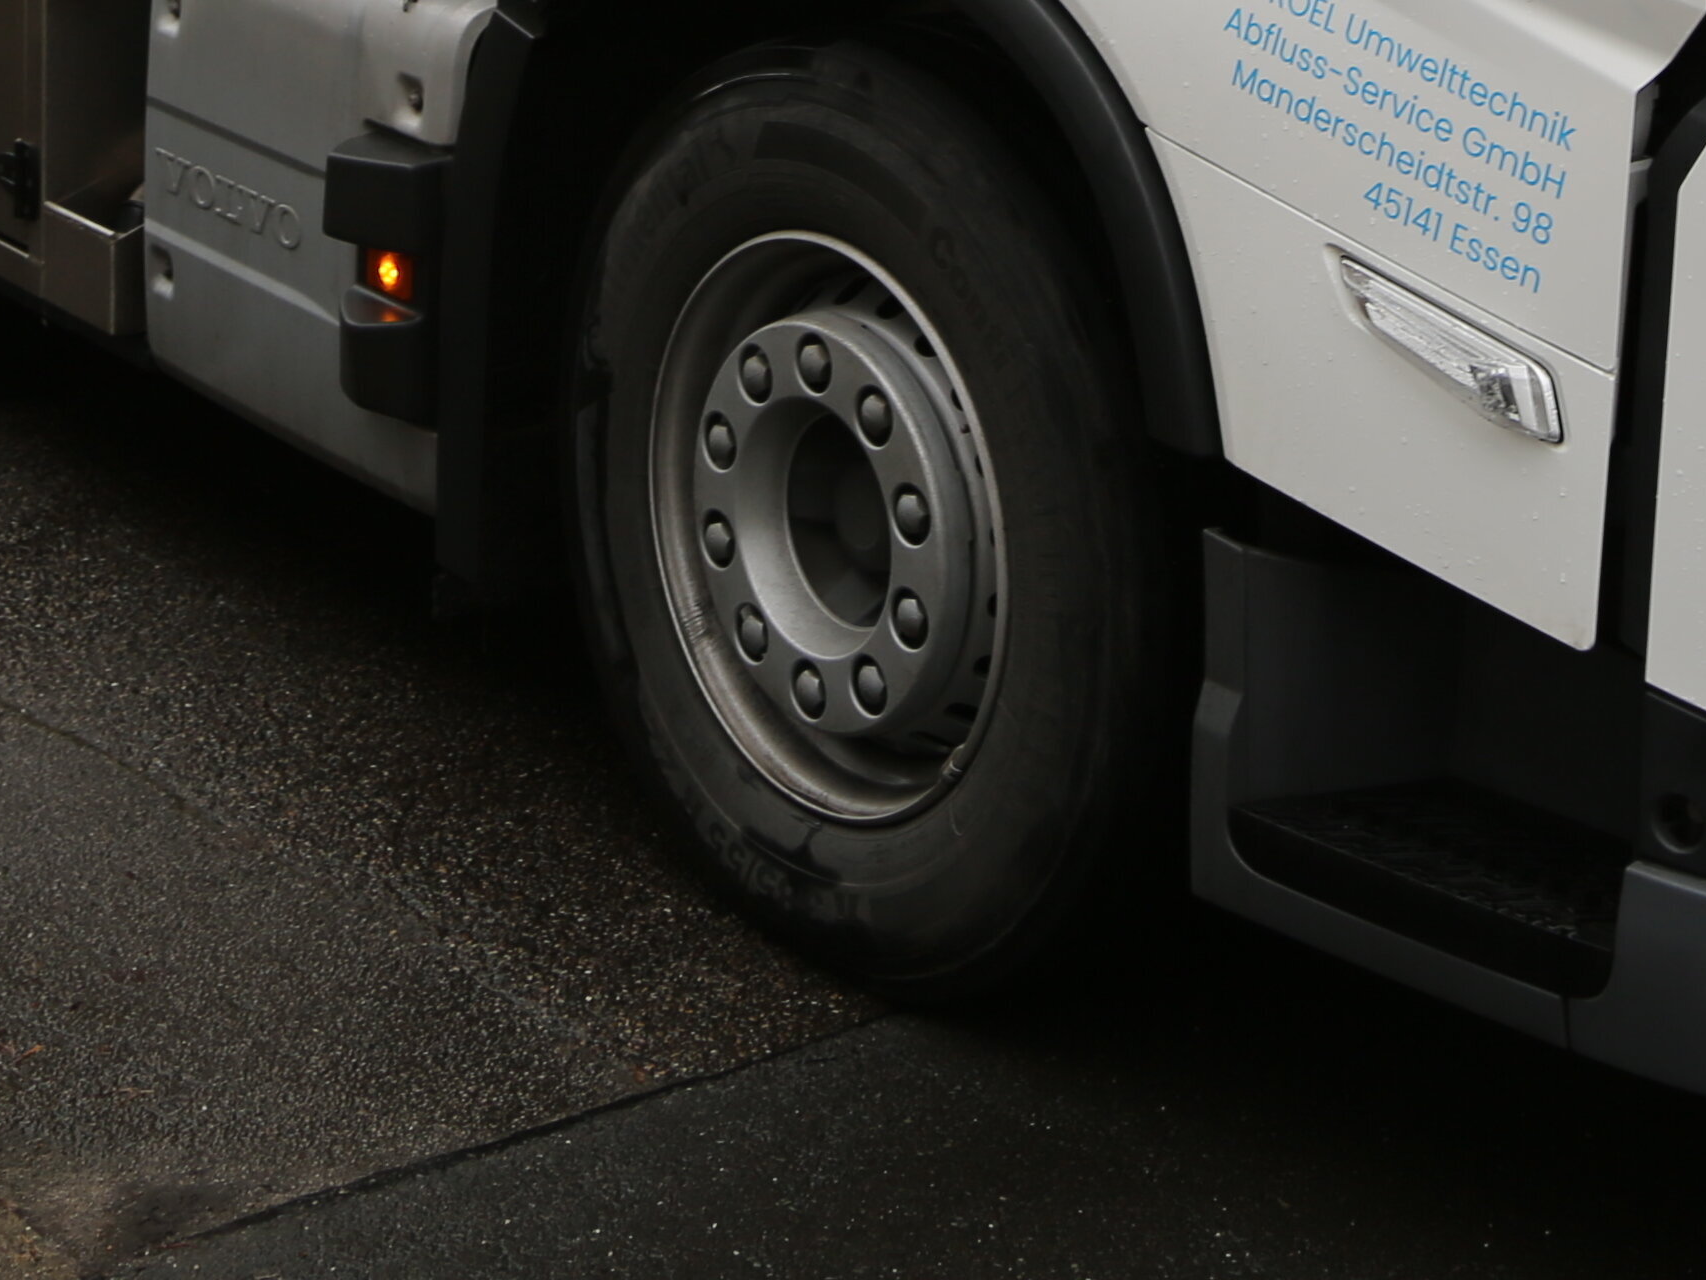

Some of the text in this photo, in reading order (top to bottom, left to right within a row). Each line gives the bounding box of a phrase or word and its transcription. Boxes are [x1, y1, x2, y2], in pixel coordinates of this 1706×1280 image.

[1223, 7, 1567, 200] Abfluss-Service GmbH
[1344, 13, 1578, 152] Umwelttechnik
[155, 147, 301, 250] VOLVO
[1231, 60, 1554, 246] Manderscheidtstr. 98
[1363, 181, 1542, 294] 45141 Essen
